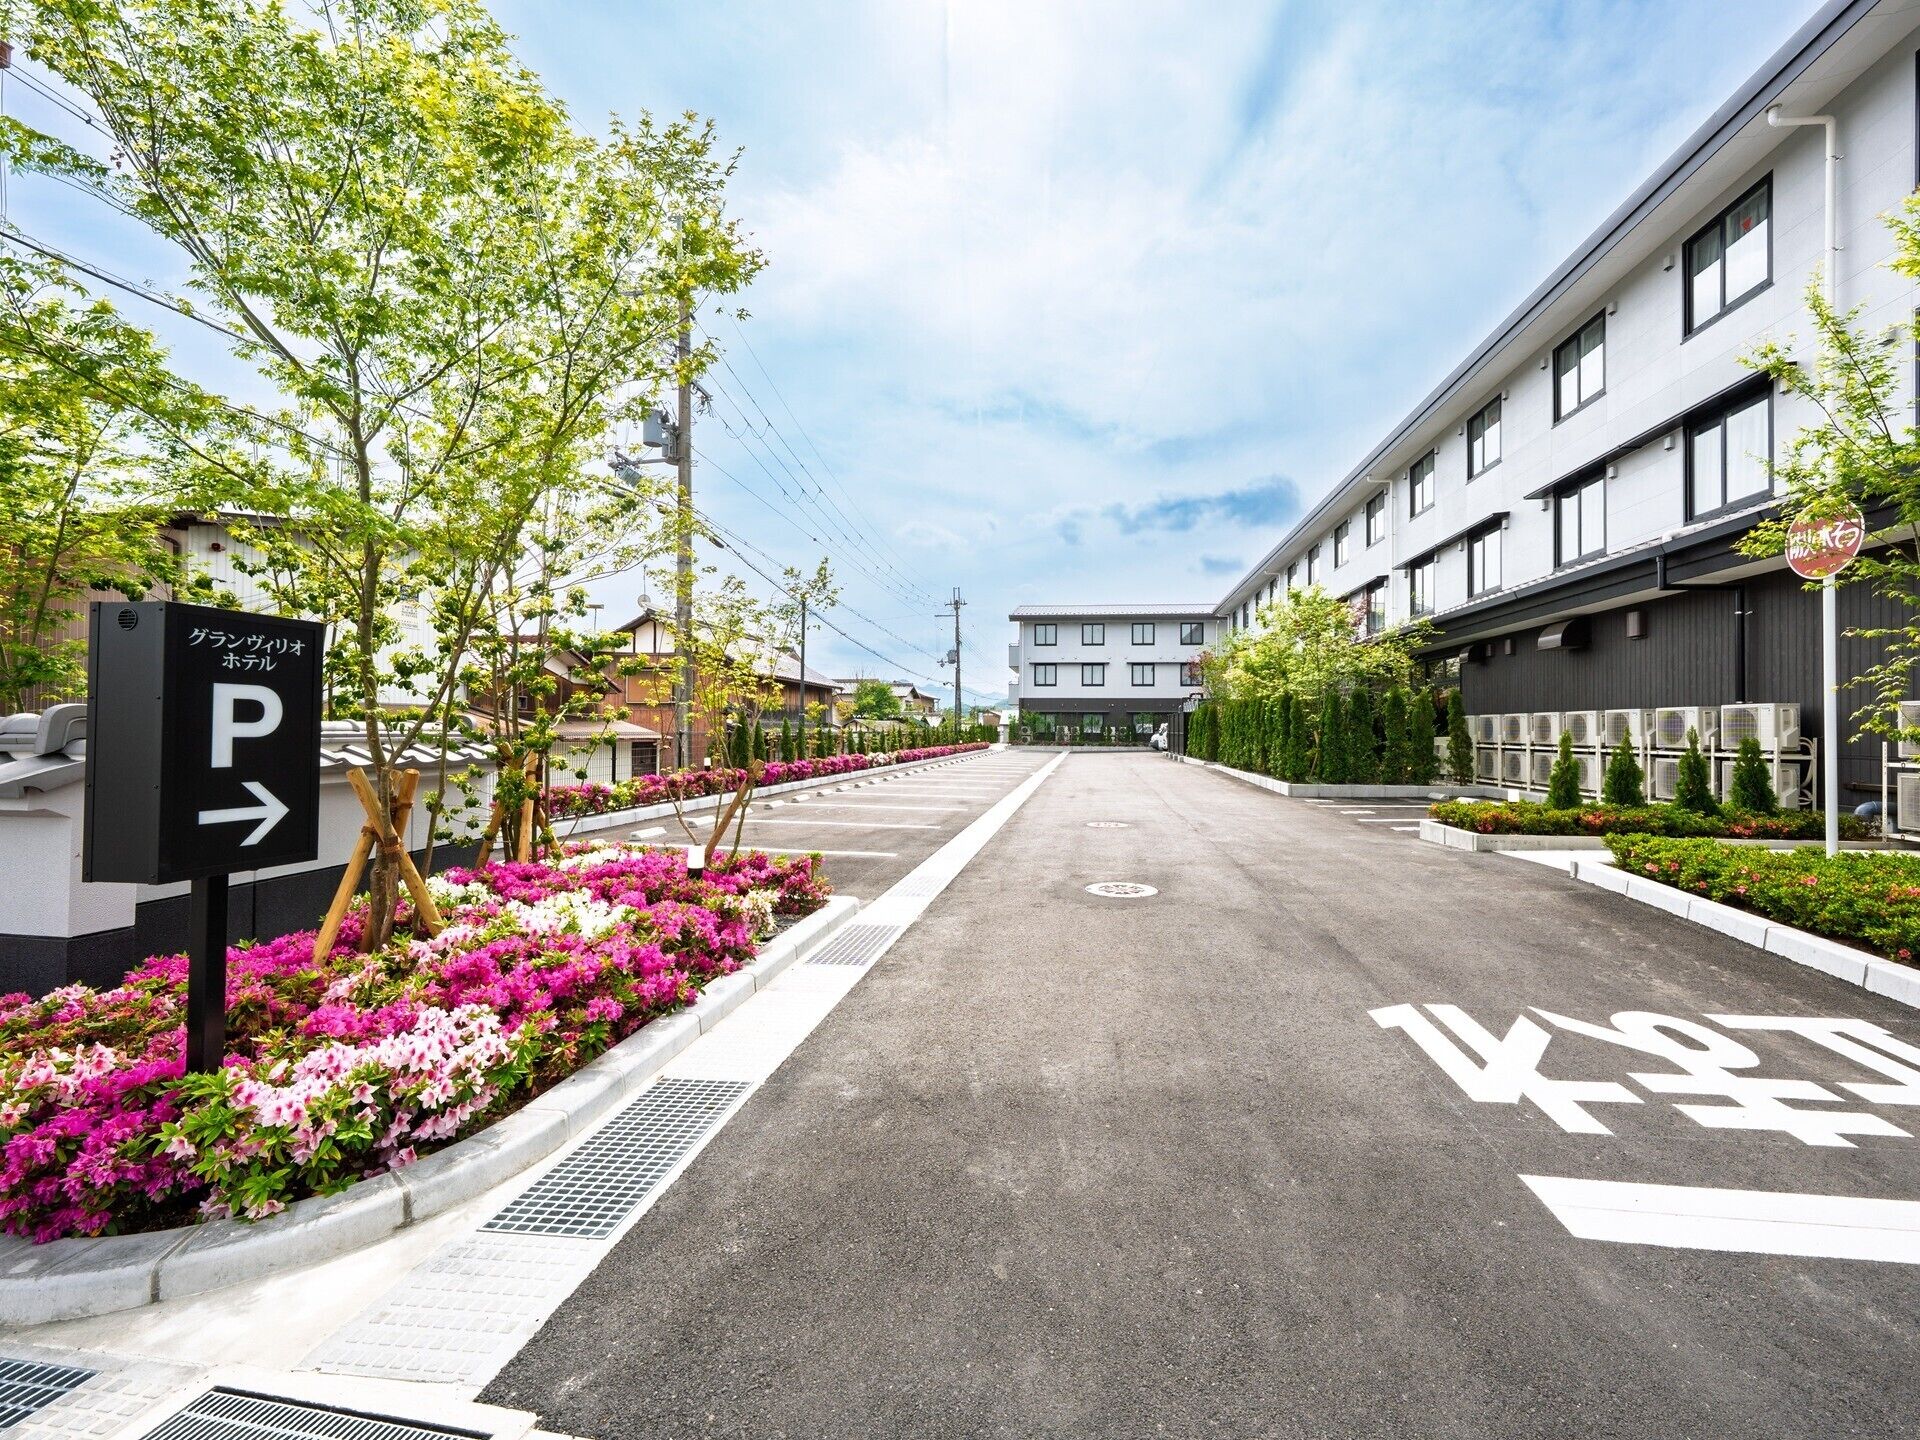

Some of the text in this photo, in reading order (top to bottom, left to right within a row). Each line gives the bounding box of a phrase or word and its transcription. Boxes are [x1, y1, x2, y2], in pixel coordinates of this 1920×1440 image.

[188, 628, 305, 656] グランヴィリオ
[222, 652, 277, 672] ホテル
[211, 682, 283, 768] P
